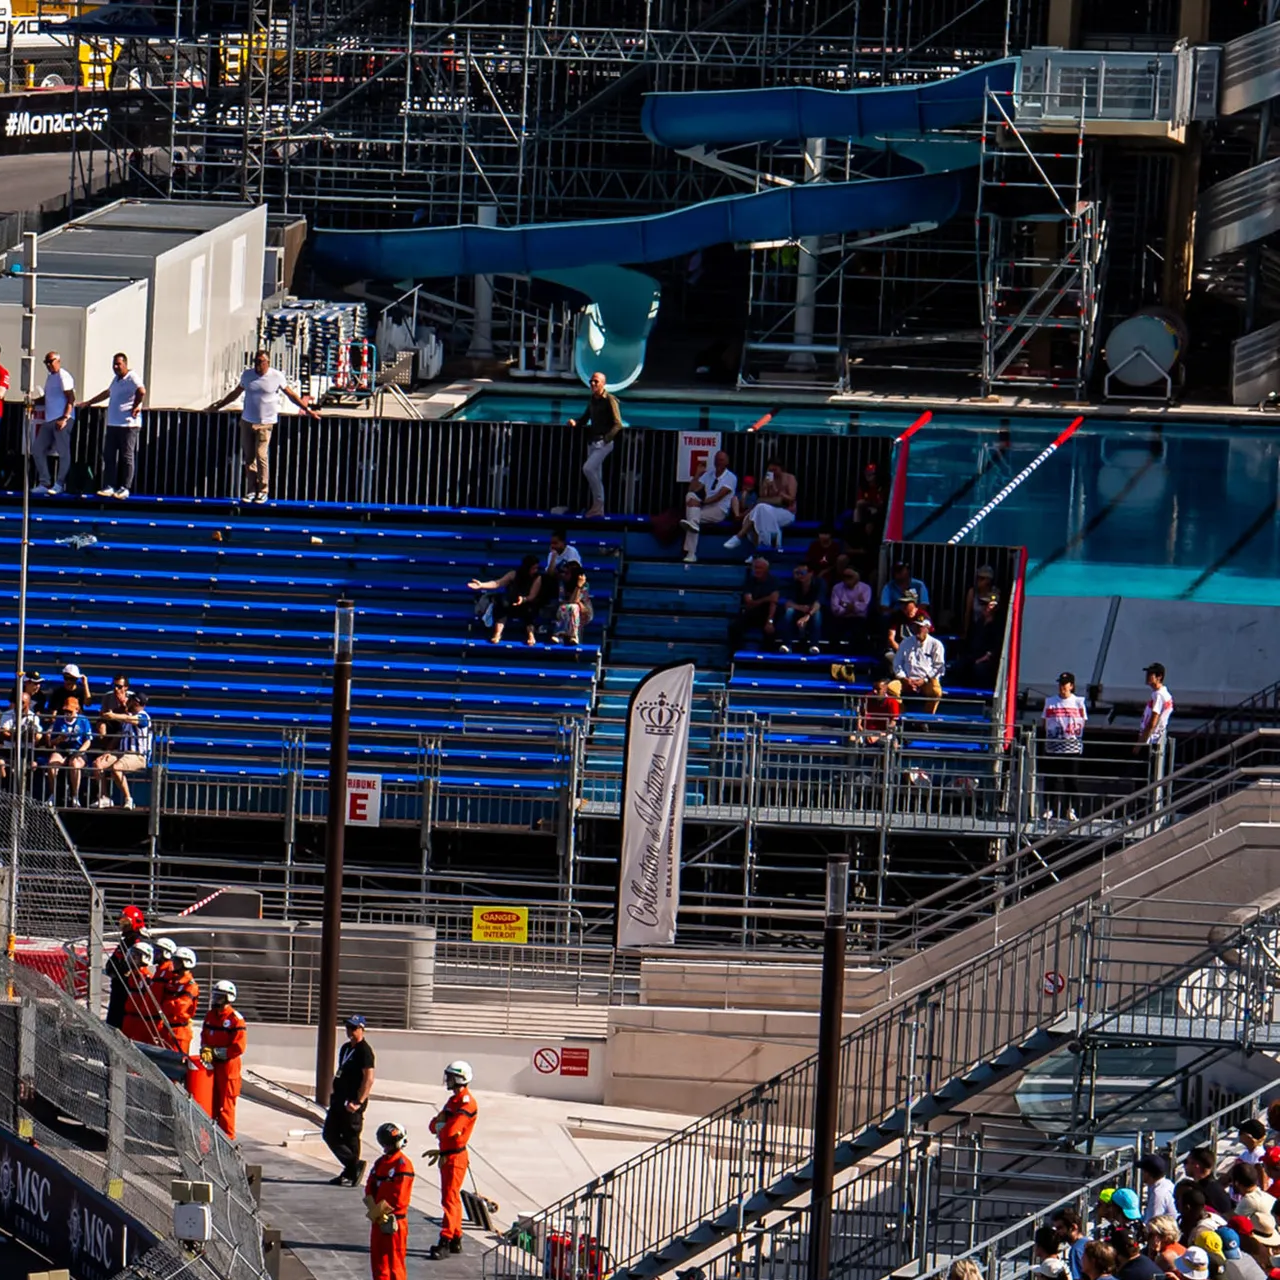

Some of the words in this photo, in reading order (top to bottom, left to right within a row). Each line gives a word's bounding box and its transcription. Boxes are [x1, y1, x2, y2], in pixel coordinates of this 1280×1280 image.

[684, 436, 716, 446] TRIBUNE
[347, 778, 376, 790] RIBUNE
[634, 754, 667, 826] Voitures
[349, 793, 368, 821] E
[646, 827, 661, 843] de
[627, 843, 660, 927] Collection
[16, 1161, 50, 1221] MSC
[83, 1208, 113, 1268] MSC
